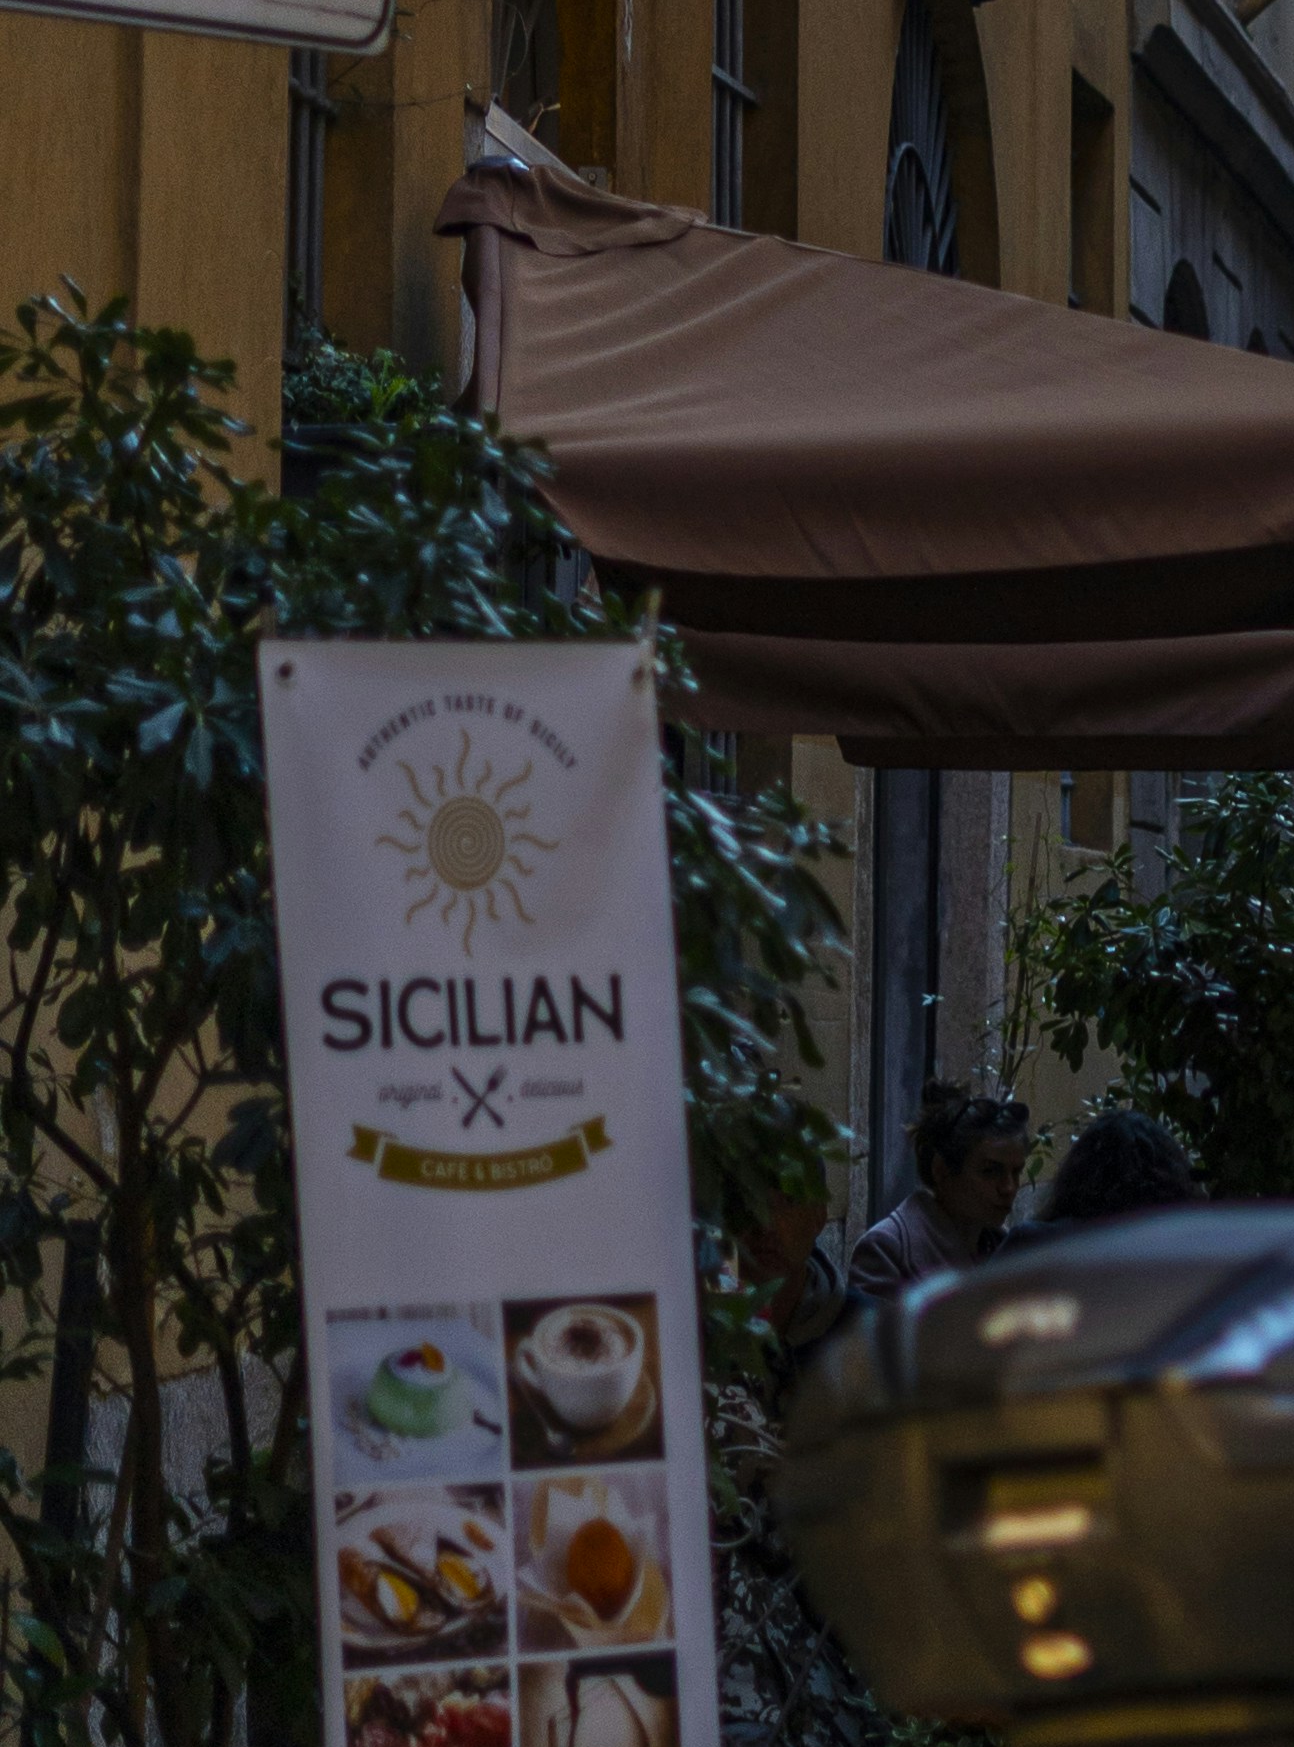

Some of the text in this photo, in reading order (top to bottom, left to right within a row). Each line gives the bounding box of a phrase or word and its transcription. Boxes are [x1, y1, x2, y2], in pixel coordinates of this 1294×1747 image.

[357, 693, 578, 772] AUTHENTIC TASTE OF SICILY
[320, 972, 626, 1052] SICILIAN
